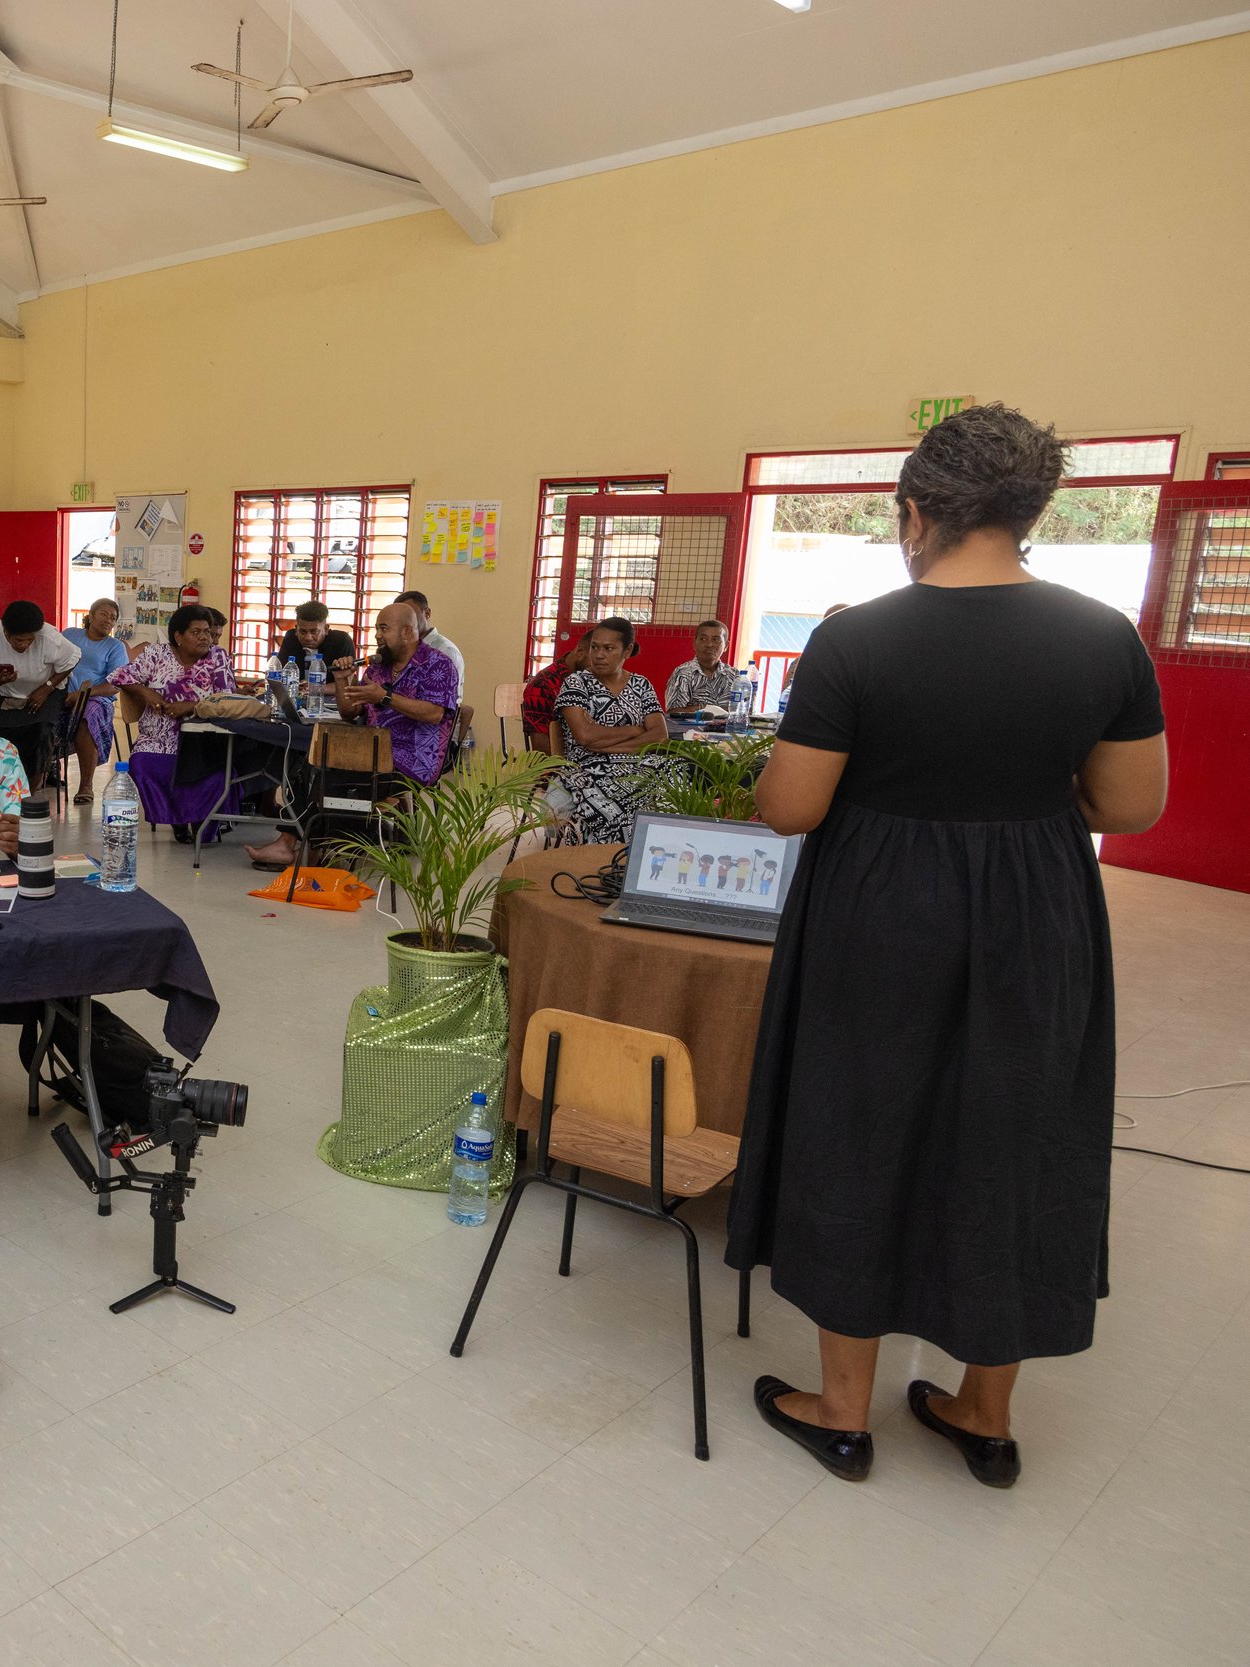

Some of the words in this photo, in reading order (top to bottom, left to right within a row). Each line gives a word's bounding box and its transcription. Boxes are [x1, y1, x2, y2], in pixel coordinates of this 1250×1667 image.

[917, 398, 964, 430] EXIT
[73, 484, 88, 501] EXIT
[670, 886, 683, 894] Any
[685, 888, 717, 897] Questions
[121, 1138, 155, 1157] RONIN
